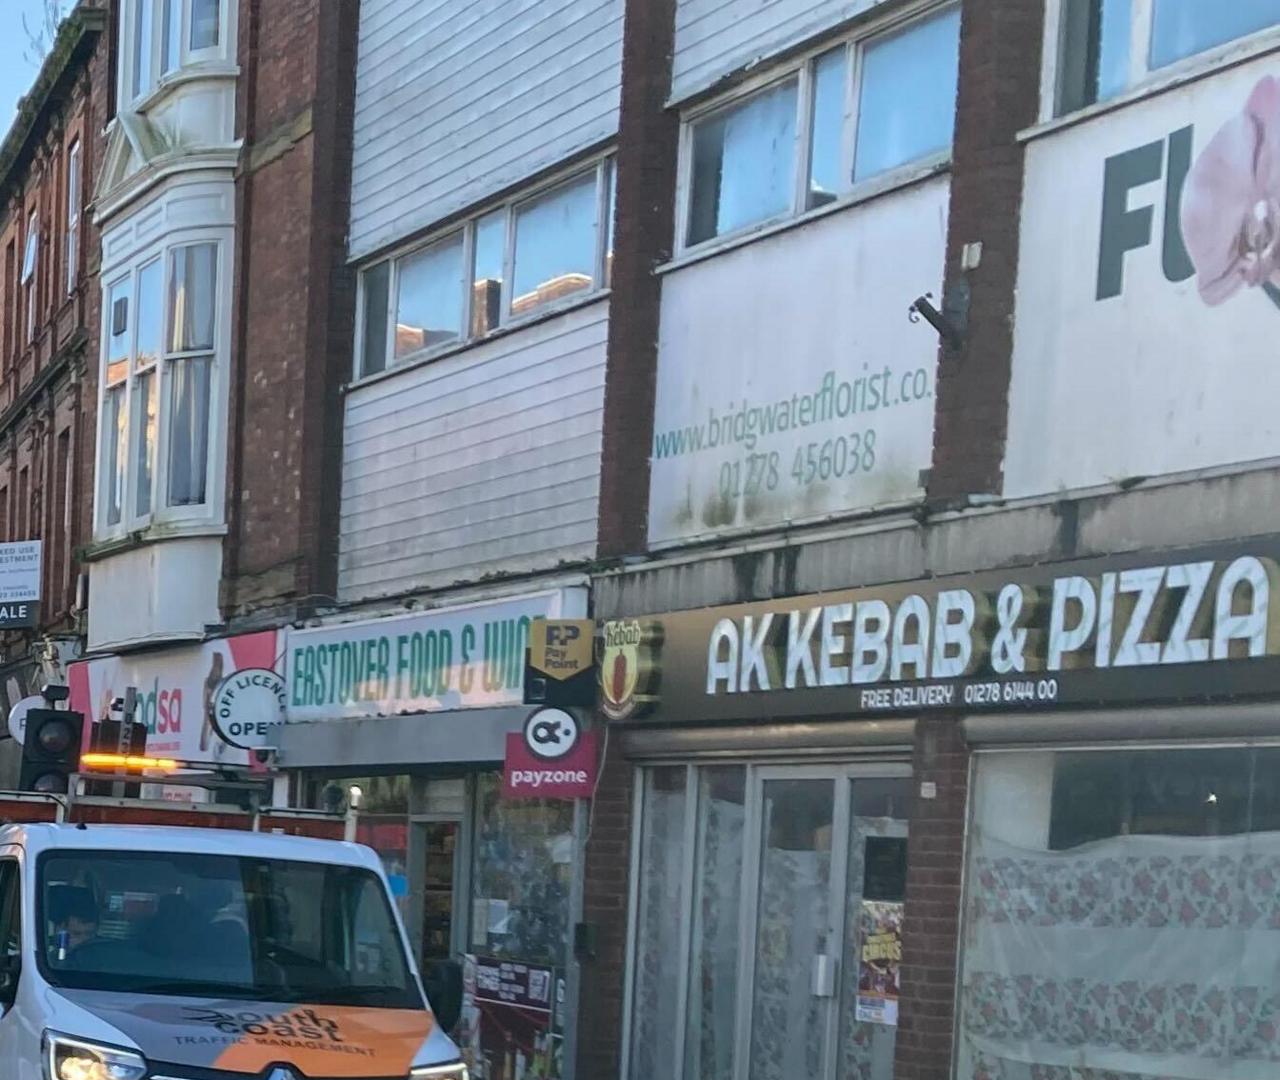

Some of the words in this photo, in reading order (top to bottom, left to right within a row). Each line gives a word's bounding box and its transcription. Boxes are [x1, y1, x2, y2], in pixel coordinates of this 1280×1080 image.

[719, 451, 780, 500] 01278
[791, 428, 876, 486] 456038
[606, 622, 640, 647] Kebab
[706, 612, 776, 695] AK
[785, 588, 976, 690] KEBAB
[990, 582, 1029, 674] &
[1047, 554, 1271, 671] PIZZA
[293, 632, 390, 707] EASTOVER
[397, 629, 452, 698] FOOD
[483, 614, 546, 692] WIN
[544, 658, 579, 669] Point
[545, 648, 568, 659] Pay
[220, 688, 235, 719] OFF
[861, 689, 891, 709] FREE
[894, 685, 954, 707] DELIVERY
[964, 682, 1001, 703] 01278
[1004, 680, 1034, 701] 6144
[1037, 678, 1058, 699] 00
[229, 721, 282, 736] OPE
[510, 768, 588, 788] payzone
[174, 1035, 248, 1046] TRAFFIC
[253, 1037, 379, 1058] MANAGEMENT
